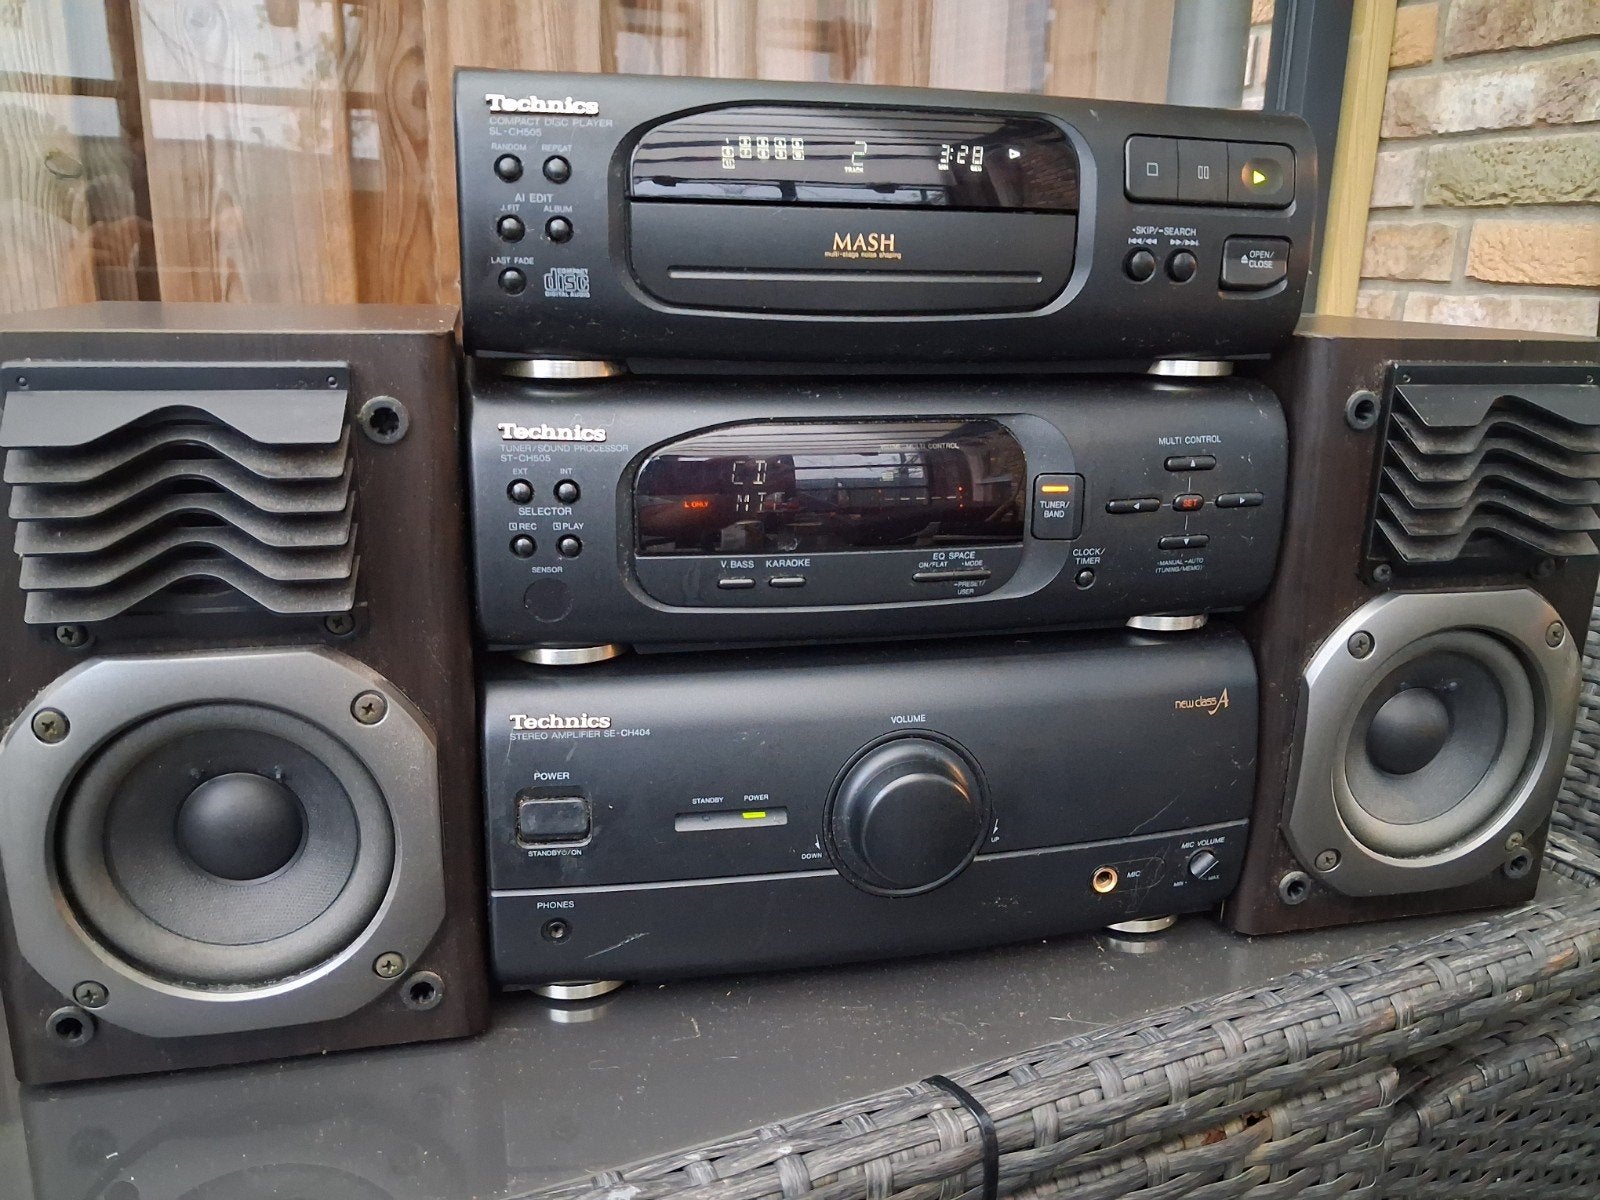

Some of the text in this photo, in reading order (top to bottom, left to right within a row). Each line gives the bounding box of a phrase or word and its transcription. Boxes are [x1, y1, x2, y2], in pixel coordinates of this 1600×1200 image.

[485, 93, 600, 115] Technics
[489, 116, 613, 128] COMPACT DISC PLAYER
[491, 142, 527, 151] RANDOM
[541, 143, 572, 152] REPEAT
[514, 193, 554, 203] AI EDIT
[543, 204, 573, 213] ALBUM
[832, 232, 895, 252] MASH
[490, 256, 535, 265] LAST FADE
[1248, 259, 1274, 269] CLOSE
[497, 422, 607, 441] Technics
[1158, 434, 1222, 445] MULTI CONTROL
[573, 444, 629, 453] PROCESSOR
[500, 454, 551, 463] ST-CH505
[512, 467, 528, 475] EXT
[560, 467, 573, 475] INT
[1183, 498, 1198, 508] SET
[518, 507, 572, 516] SELECTOR
[1043, 509, 1065, 519] BAND
[519, 522, 538, 531] REC
[562, 522, 585, 531] PLAY
[948, 551, 976, 560] SPACE
[765, 558, 811, 568] KARAOKE
[1075, 556, 1101, 565] TIMER
[531, 566, 563, 574] SENSOR
[509, 713, 611, 731] Technics
[890, 714, 926, 724] VOLUME
[509, 728, 651, 741] STEREO AMPLIFIER SE-CH404
[533, 771, 570, 781] POWER
[692, 796, 724, 805] STANDBY
[743, 793, 769, 801] POWER
[1181, 836, 1226, 850] MIC VOLUME
[801, 852, 823, 860] DOWN
[1126, 870, 1141, 878] MIC
[536, 900, 575, 910] PHONES
